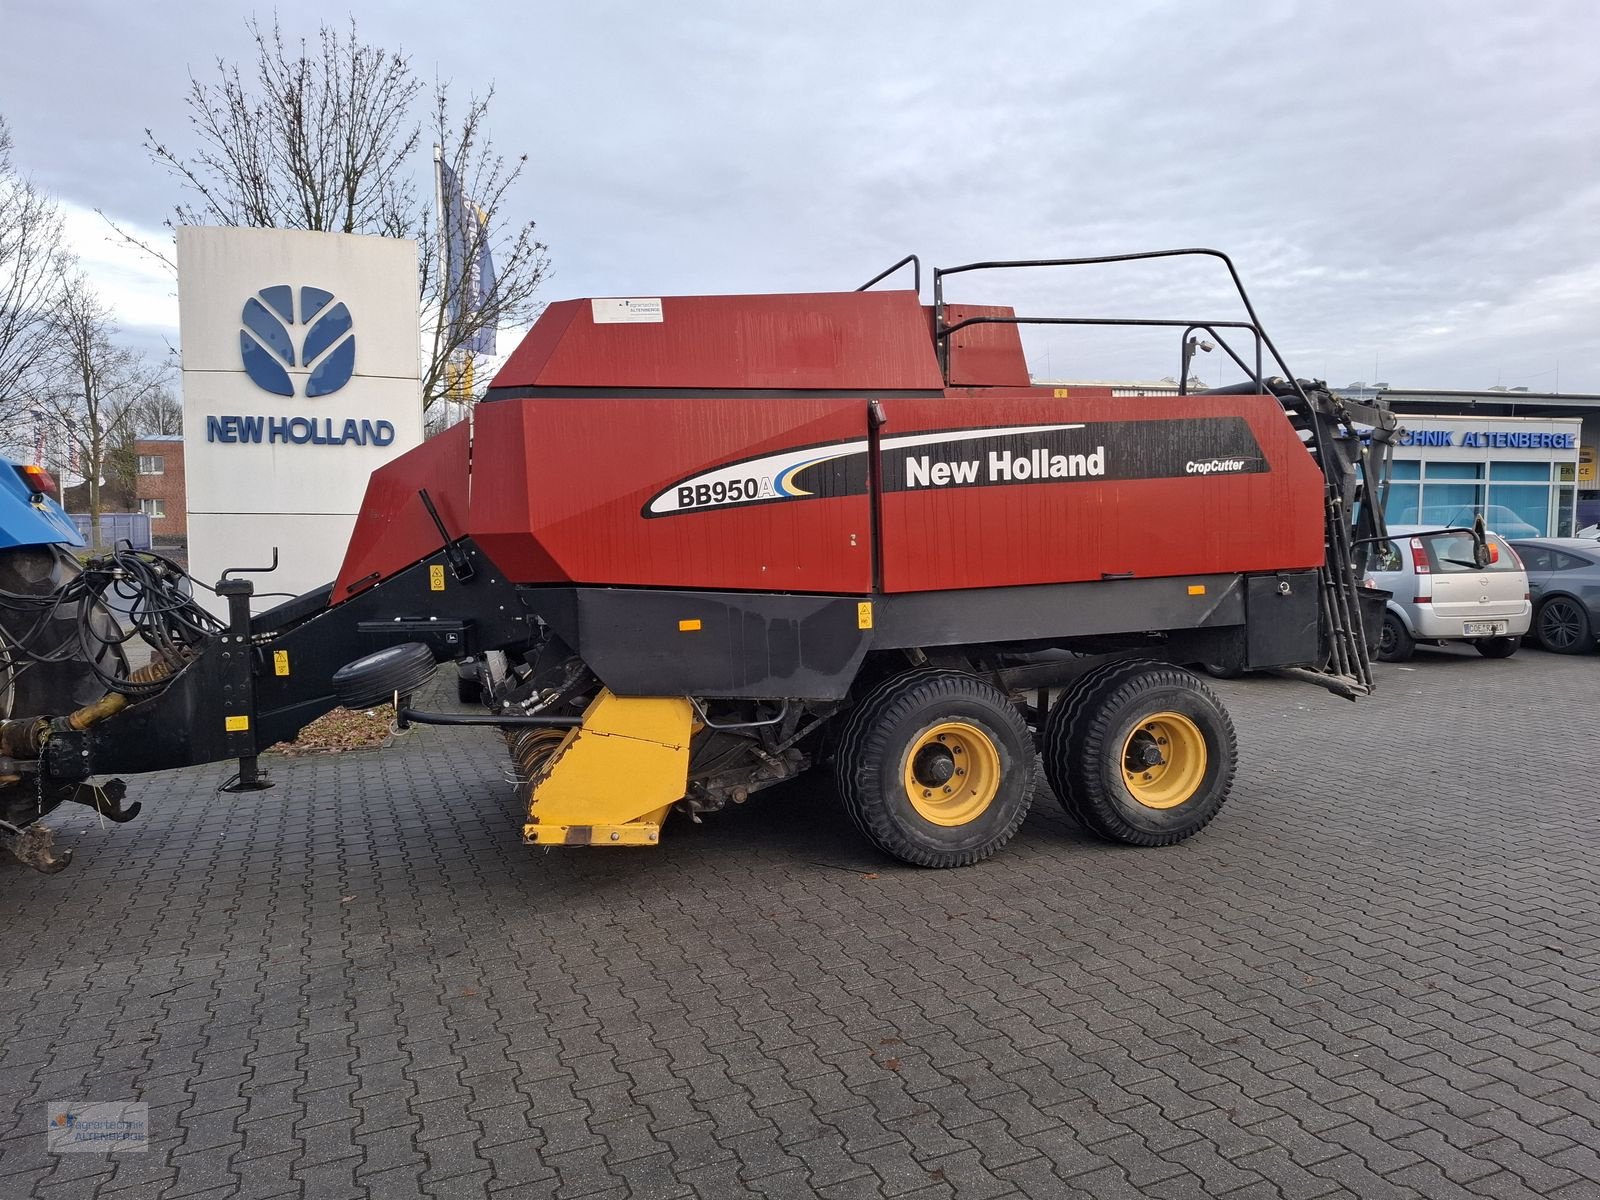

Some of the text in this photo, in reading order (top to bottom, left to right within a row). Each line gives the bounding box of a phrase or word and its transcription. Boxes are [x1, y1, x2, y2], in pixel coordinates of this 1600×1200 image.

[207, 416, 395, 447] NEW HOLLAND
[1462, 431, 1577, 449] ALTENBERGE
[906, 446, 1105, 488] New Holland
[1186, 459, 1245, 475] CropCutter
[678, 476, 776, 508] BB950A
